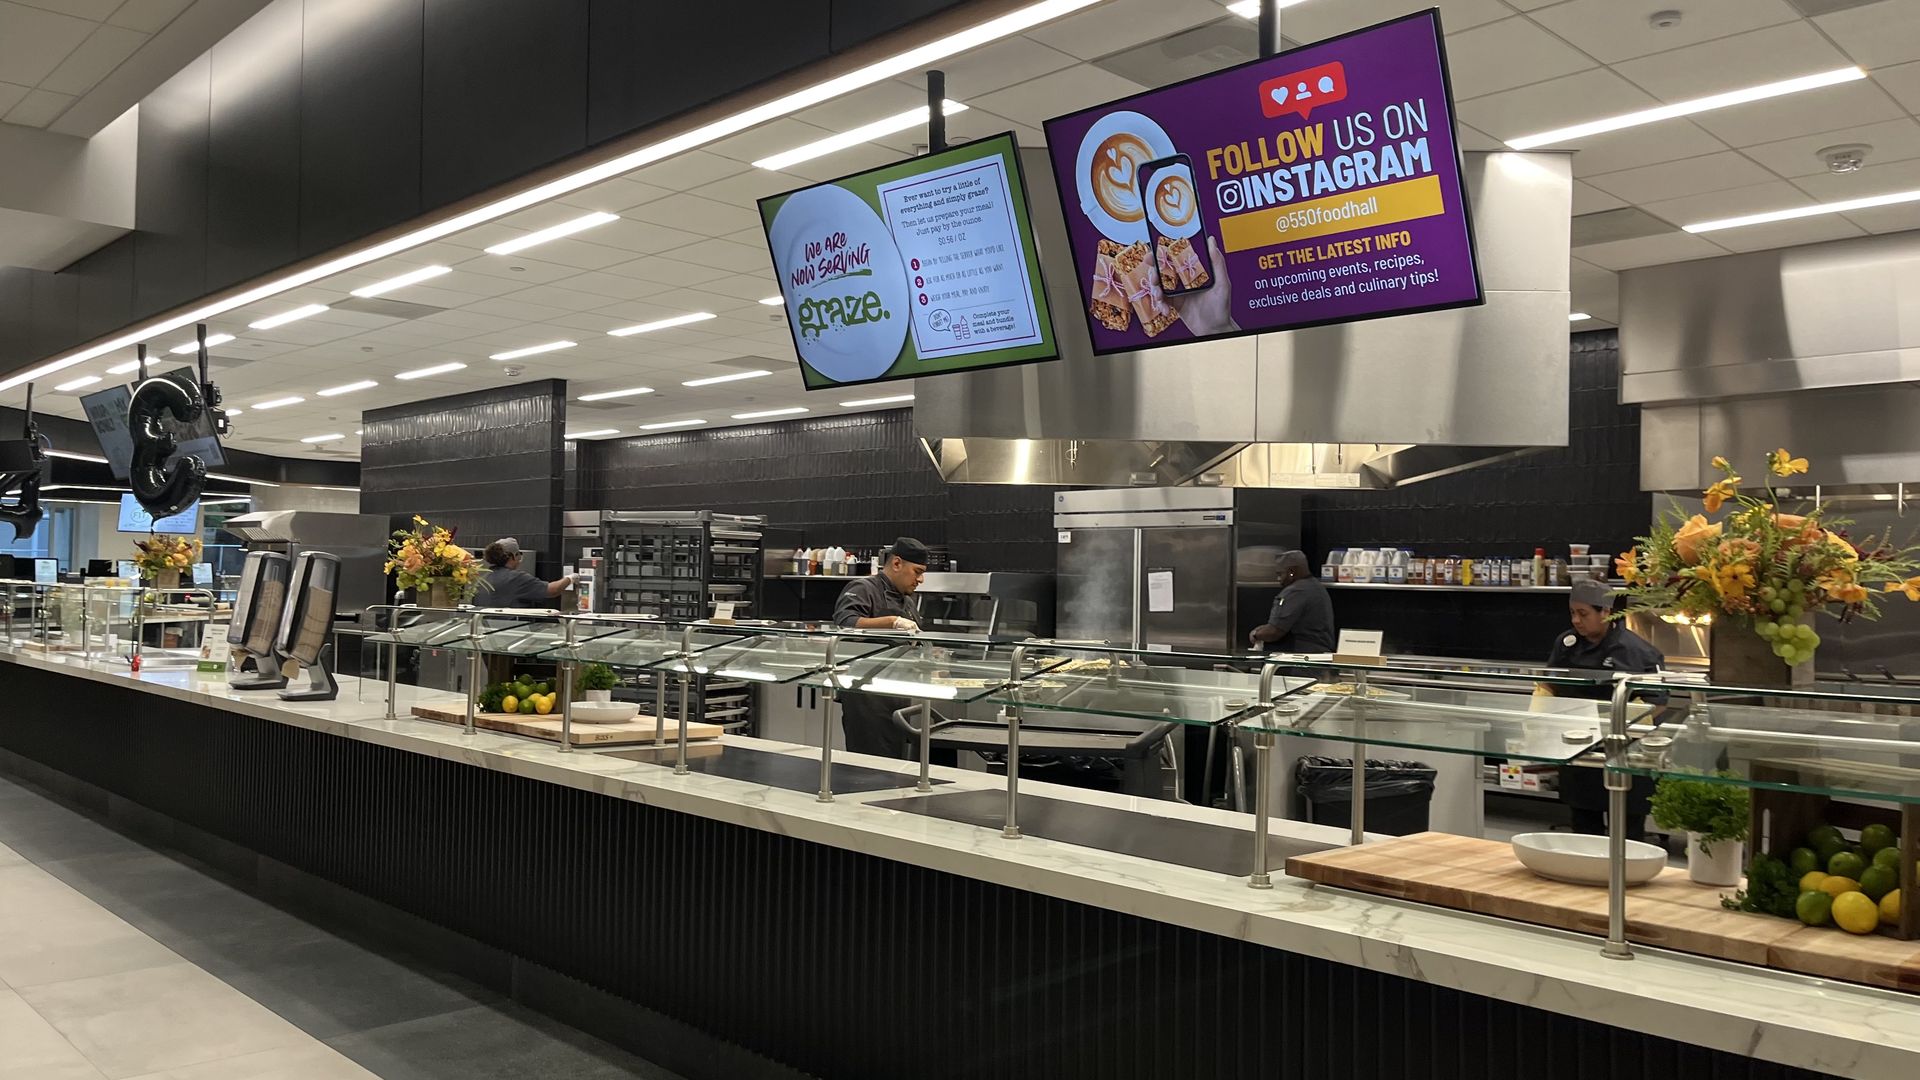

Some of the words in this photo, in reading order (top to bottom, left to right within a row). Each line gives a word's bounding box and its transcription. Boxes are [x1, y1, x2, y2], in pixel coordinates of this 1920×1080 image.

[1206, 123, 1323, 180] FOLLOW
[1334, 111, 1375, 150] US
[1382, 98, 1428, 140] ON
[904, 193, 918, 202] Ever
[919, 190, 934, 198] want
[942, 185, 952, 194] try
[958, 179, 973, 188] little
[1243, 137, 1431, 208] INSTAGRAM
[900, 201, 932, 214] everything
[946, 192, 966, 203] simply
[967, 187, 989, 198] graze?
[903, 219, 917, 228] Then
[935, 210, 959, 221] prepare
[960, 206, 975, 216] your
[975, 201, 993, 211] meal!
[1276, 197, 1378, 233] @550foodhall
[963, 216, 982, 225] ounce.
[1258, 248, 1283, 270] GET
[1287, 244, 1314, 266] THE
[1317, 236, 1372, 263] LATEST
[1375, 230, 1412, 255] INFO
[792, 265, 814, 289] NOW
[1249, 290, 1298, 309] exclusive
[1300, 286, 1332, 304] deals
[1334, 282, 1355, 300] and
[1358, 274, 1407, 296] culinary
[1410, 268, 1440, 290] tips!
[1254, 278, 1268, 290] on
[1270, 267, 1326, 291] upcoming
[1328, 261, 1372, 281] events,
[1375, 252, 1425, 276] recipes,
[799, 291, 890, 337] graze.
[973, 310, 996, 320] Complete
